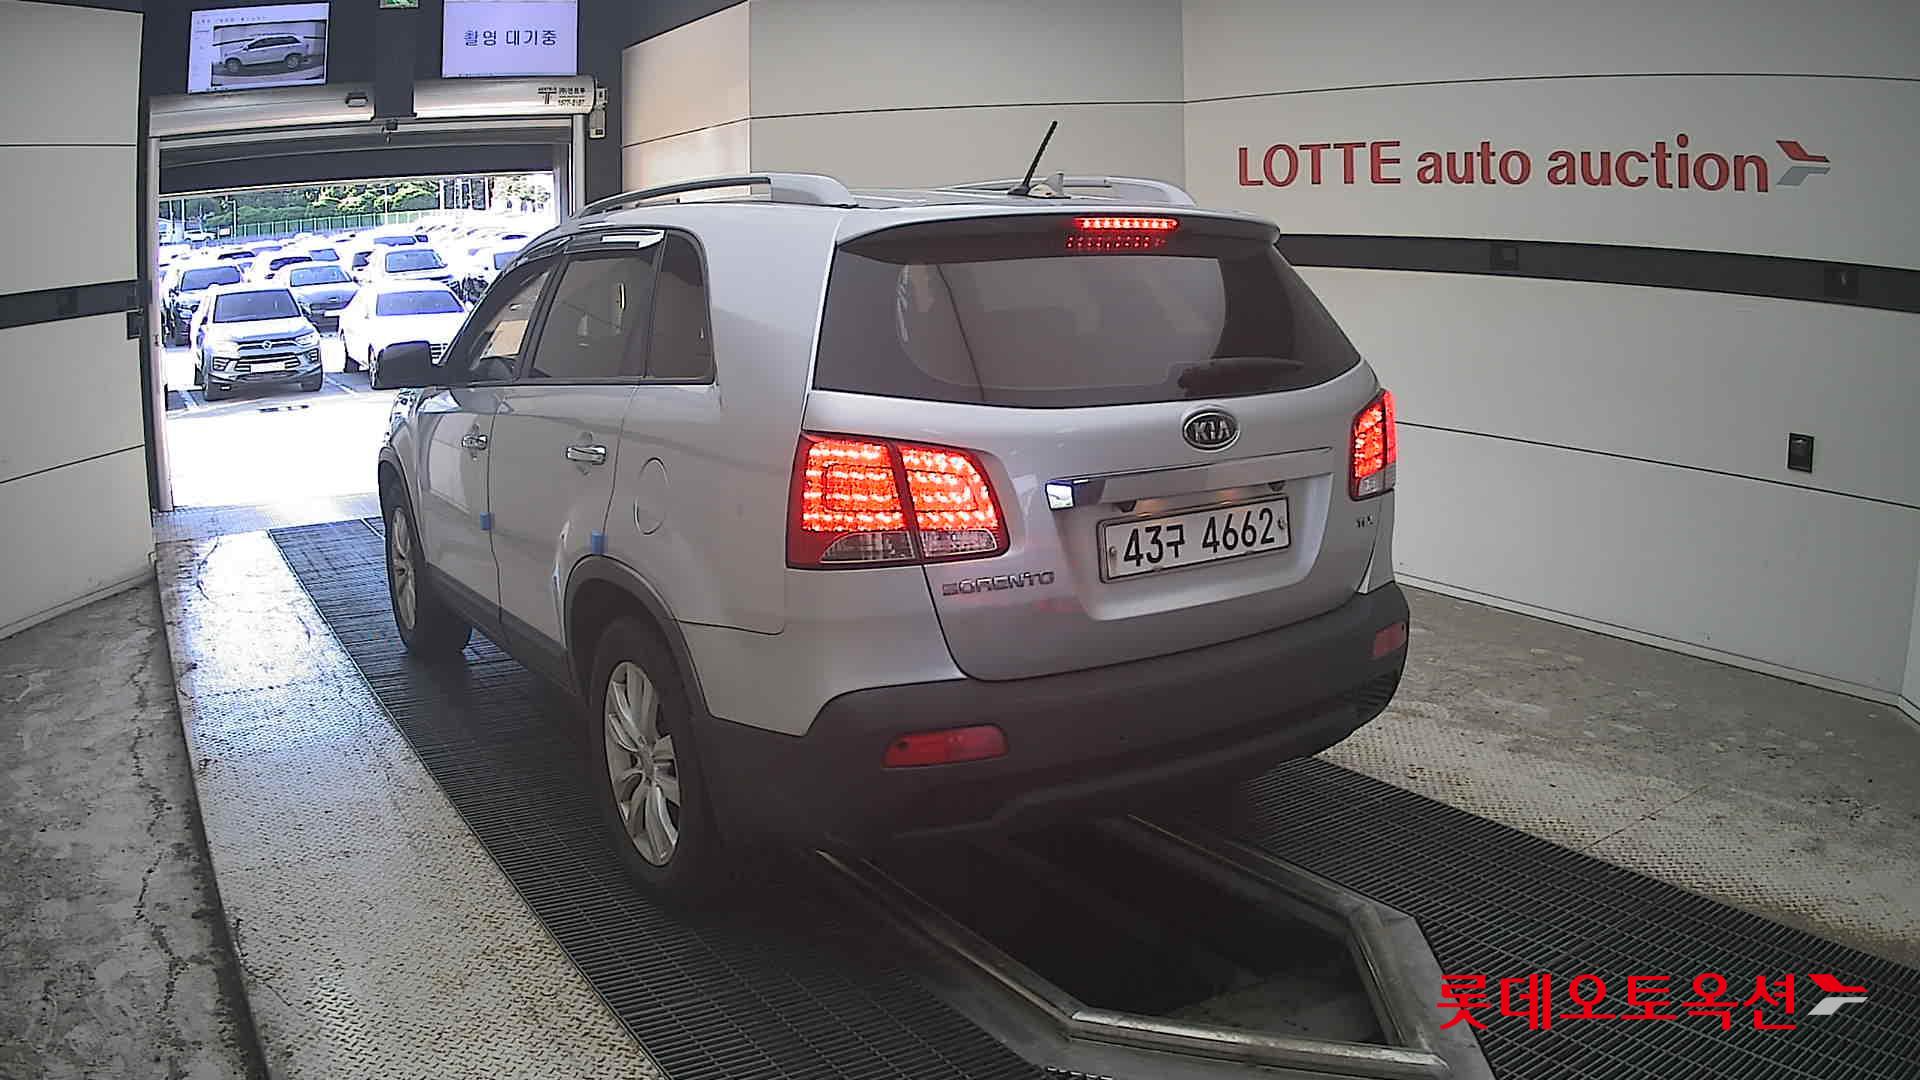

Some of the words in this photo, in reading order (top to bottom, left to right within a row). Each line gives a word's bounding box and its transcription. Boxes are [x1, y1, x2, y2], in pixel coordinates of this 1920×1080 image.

[505, 29, 557, 47] 대기중
[1238, 140, 1401, 187] LOTTE
[1416, 140, 1532, 186] auto
[1547, 133, 1769, 193] auction
[1192, 420, 1231, 441] KIA
[1123, 523, 1186, 567] 43구
[1201, 508, 1276, 553] 4662
[942, 571, 1055, 596] SORENTO
